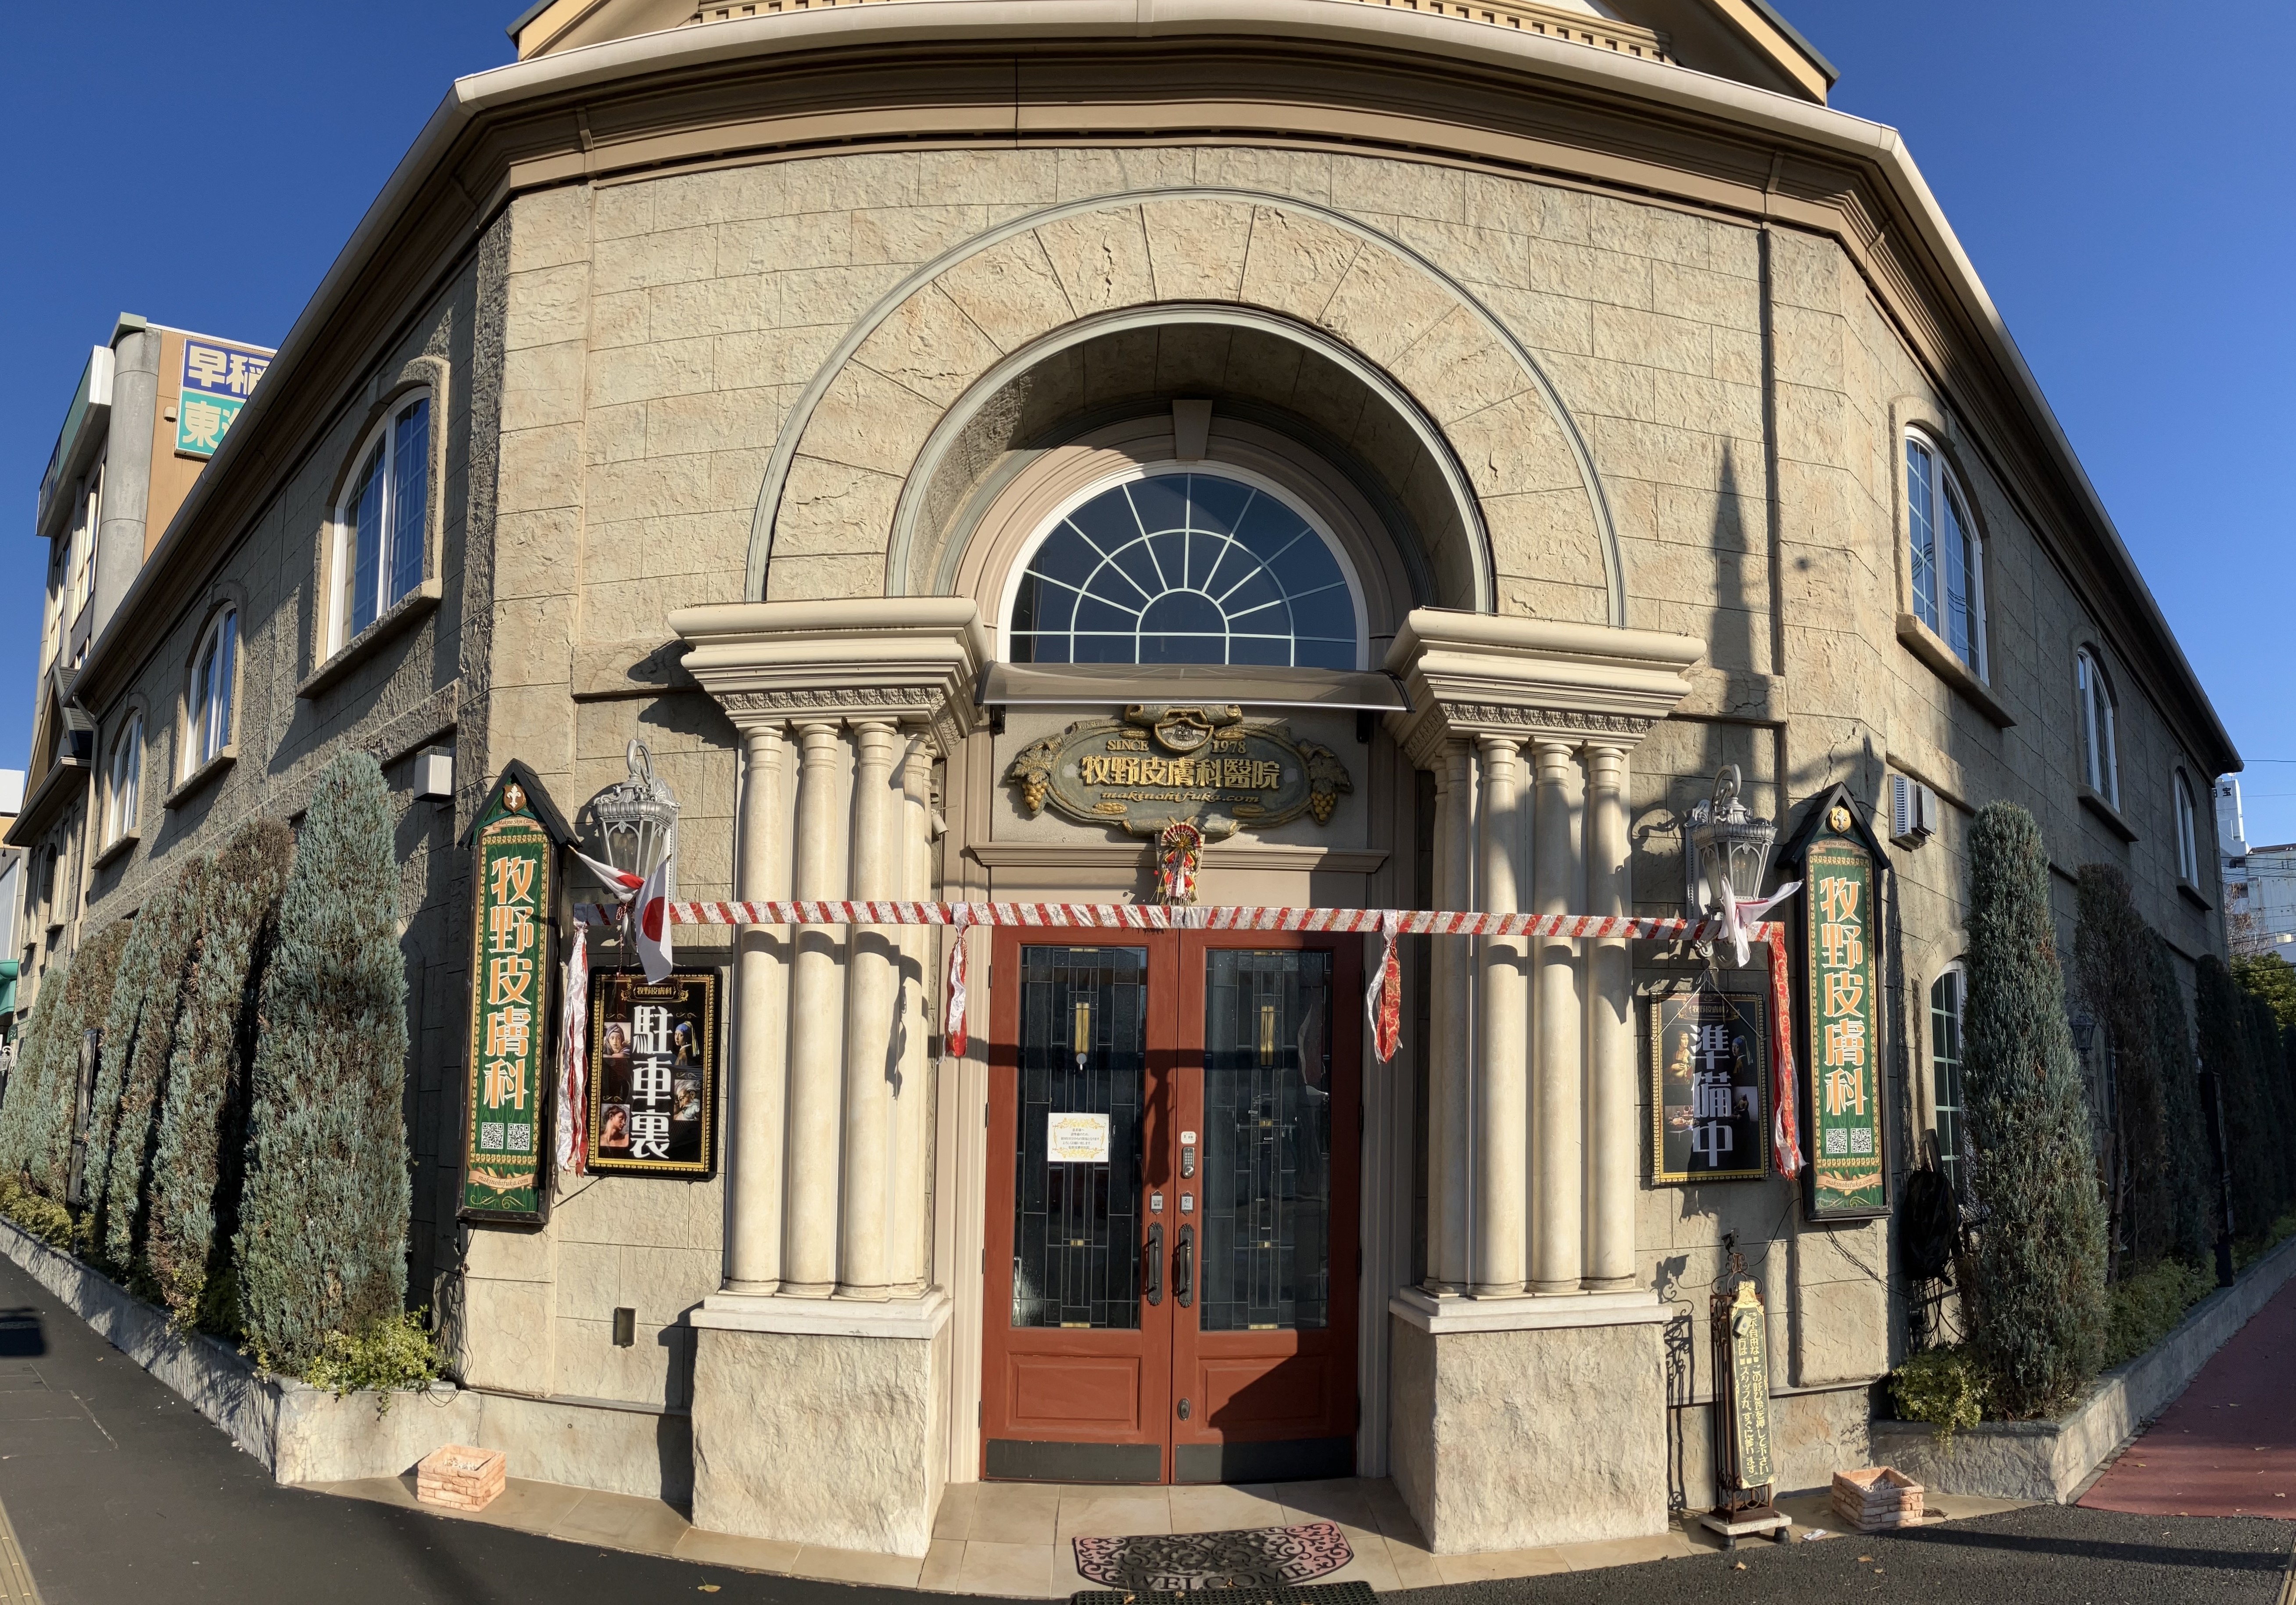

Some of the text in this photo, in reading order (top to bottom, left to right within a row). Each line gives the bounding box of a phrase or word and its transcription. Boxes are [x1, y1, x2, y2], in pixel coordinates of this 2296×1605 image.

[1107, 740, 1247, 754] SINCE 1978
[1082, 754, 1281, 790] 牧野皮膚科醫院
[1101, 790, 1260, 803] makinohifuka.com
[483, 855, 537, 1110] 牧野皮膚科
[637, 987, 672, 995] 牧野皮膚科
[1819, 876, 1868, 1116] 牧野皮膚科
[630, 1005, 673, 1159] 駐車裏
[1690, 1024, 1733, 1167] 準備中
[478, 1175, 528, 1188] makinohifuka.com
[1826, 1178, 1873, 1189] makinohifuka.com
[1131, 1562, 1315, 1590] WELCOME
